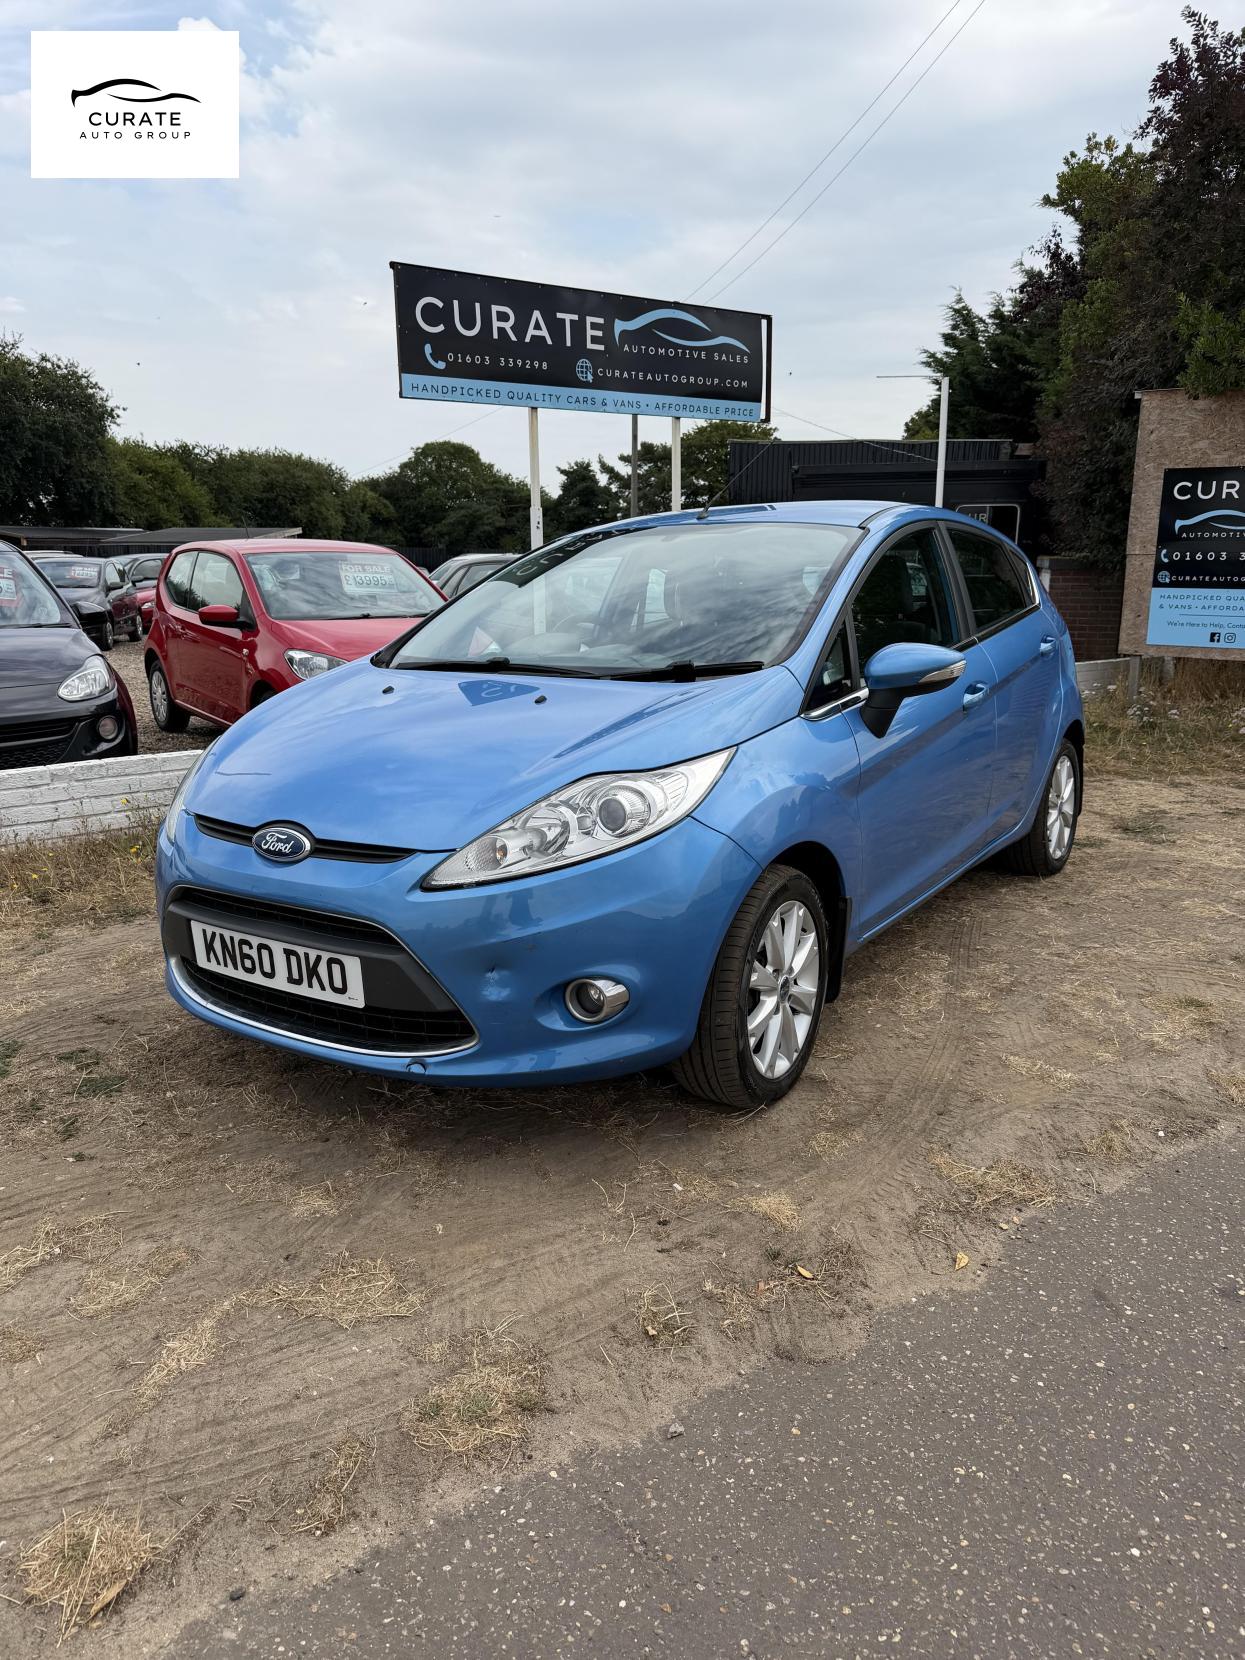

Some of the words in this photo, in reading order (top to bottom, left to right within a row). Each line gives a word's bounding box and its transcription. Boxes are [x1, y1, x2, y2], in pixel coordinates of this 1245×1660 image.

[414, 296, 605, 352] CURATE
[447, 352, 490, 365] 01603
[499, 357, 548, 370] 339298
[623, 343, 707, 360] AUTOMOTIVE
[713, 352, 749, 364] SALES
[597, 368, 748, 388] CURATEAUTOGROUP.COM
[411, 383, 501, 399] HANDPICKED
[506, 390, 561, 404] QUALITY
[566, 395, 596, 406] CARS
[601, 398, 608, 407] &
[612, 399, 642, 410] VANS
[654, 402, 720, 415] AFFORDABLE
[724, 407, 754, 417] PRICE
[1173, 480, 1240, 500] CUR
[1172, 551, 1227, 561] 01603
[261, 832, 295, 854] Ford
[202, 928, 276, 980] KN60
[283, 947, 348, 995] DKO
